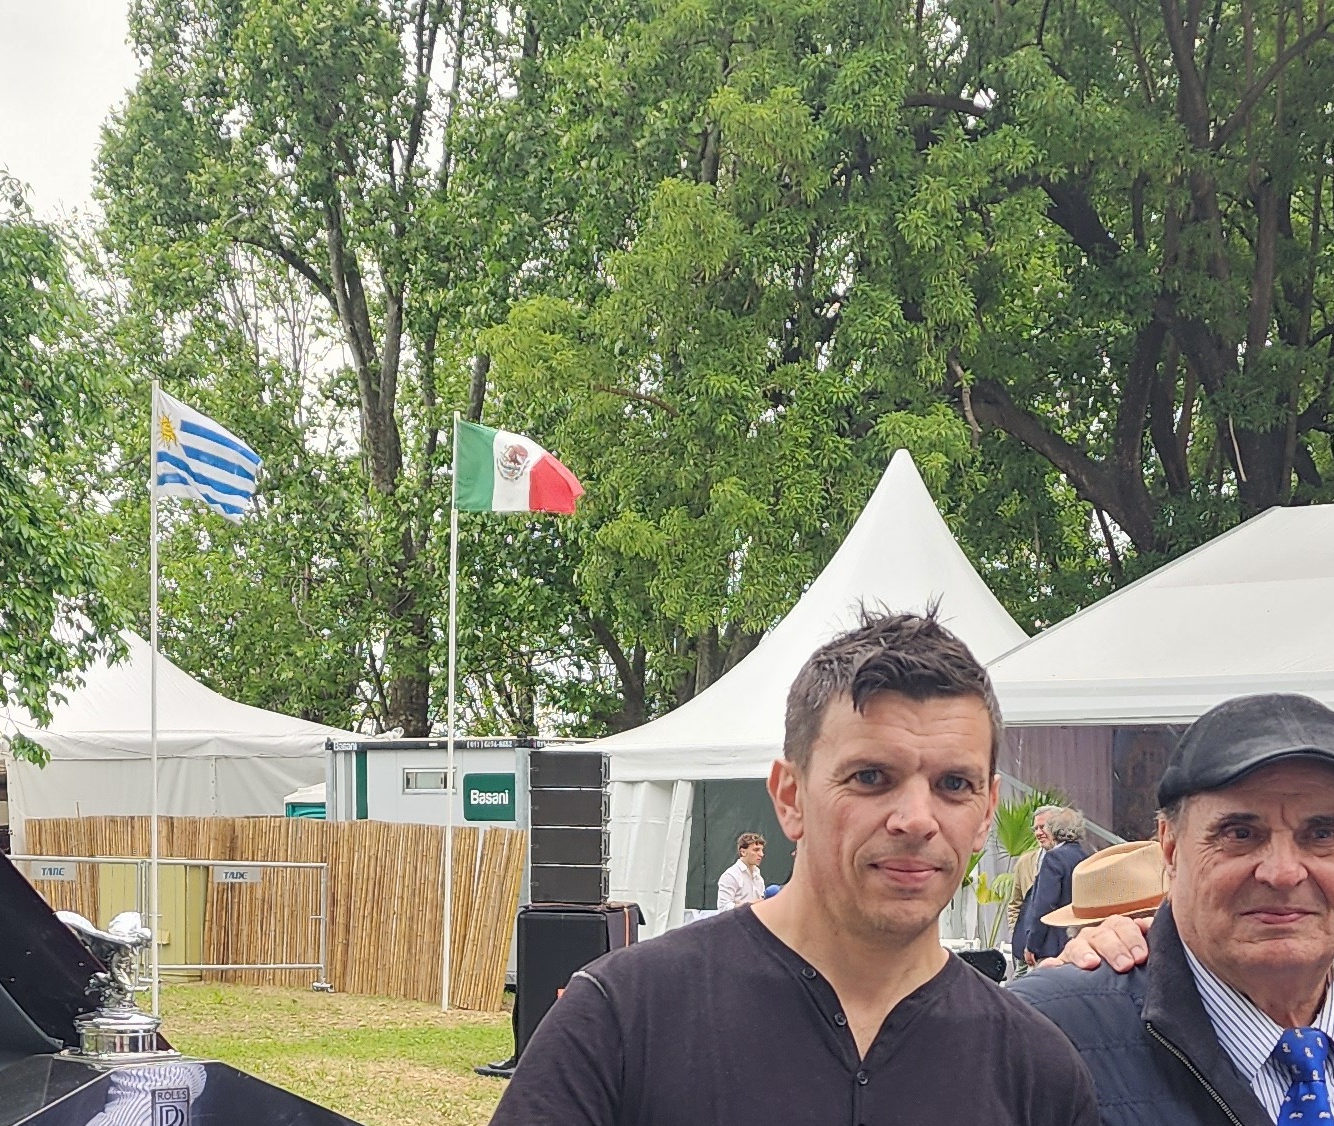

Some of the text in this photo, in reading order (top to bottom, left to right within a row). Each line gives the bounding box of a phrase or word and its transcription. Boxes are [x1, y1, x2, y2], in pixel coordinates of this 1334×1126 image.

[333, 742, 358, 751] Basani
[470, 789, 509, 805] Basani
[157, 1091, 187, 1100] ROLLS
